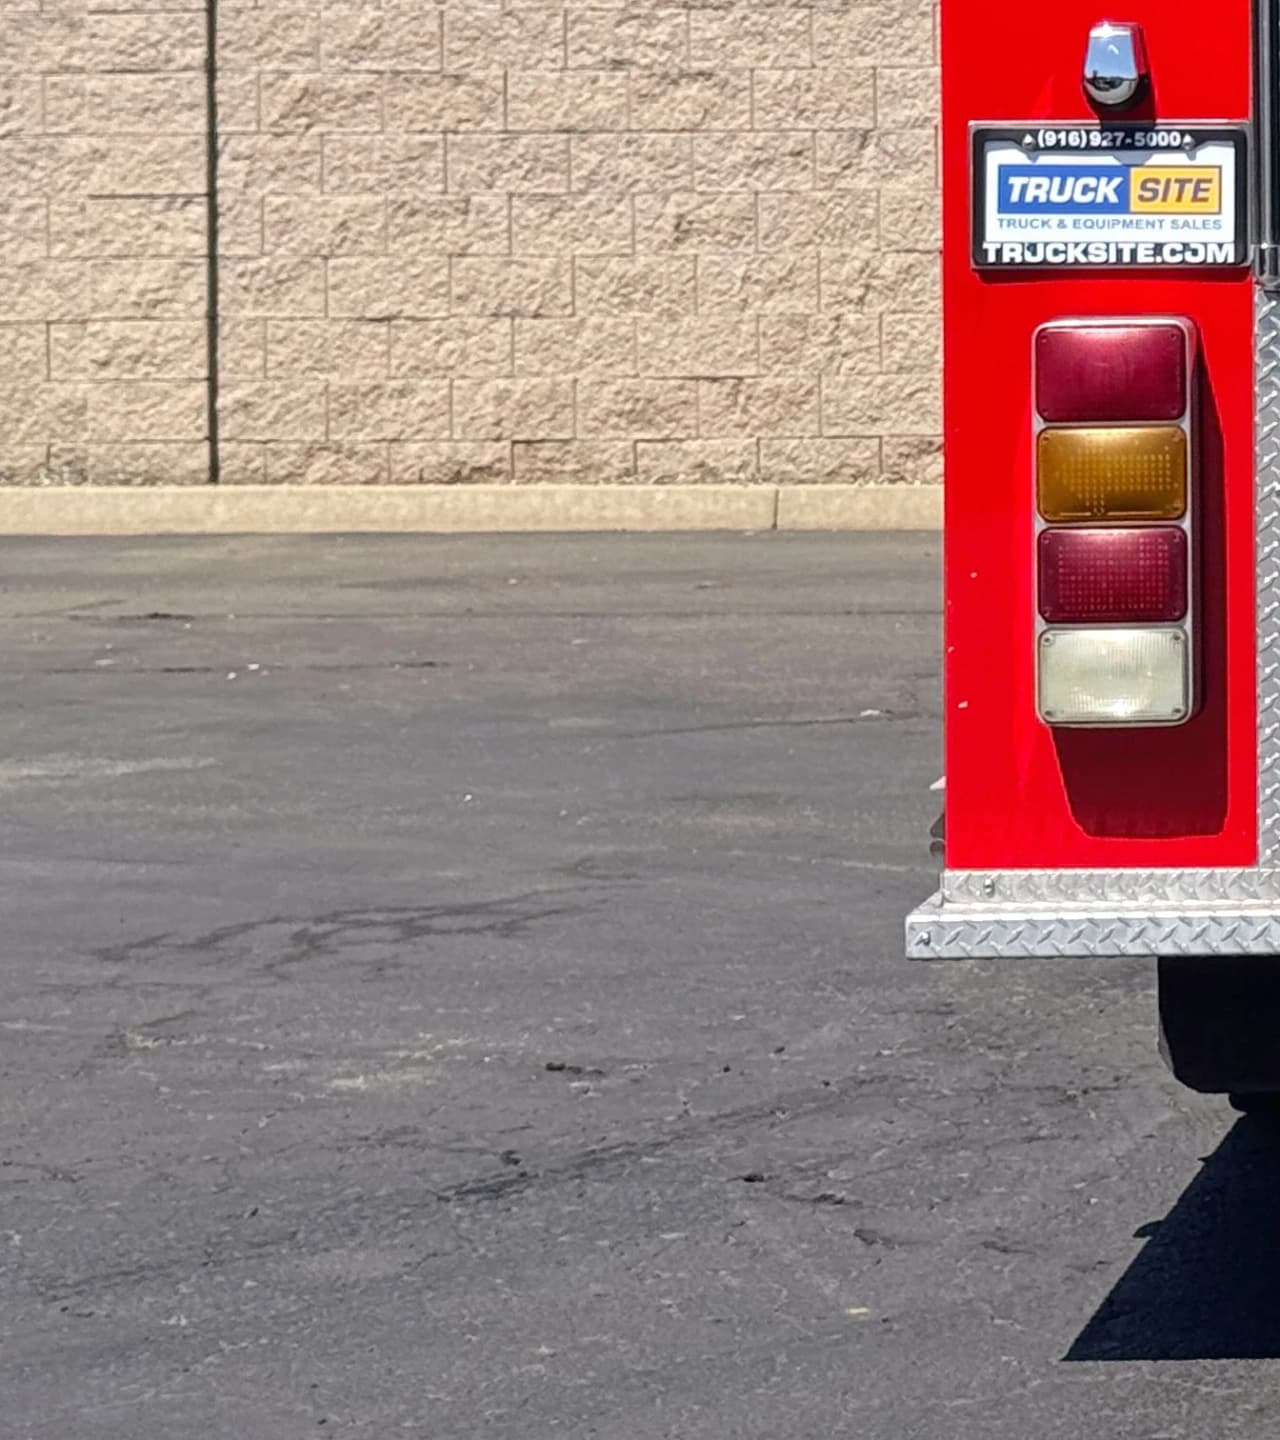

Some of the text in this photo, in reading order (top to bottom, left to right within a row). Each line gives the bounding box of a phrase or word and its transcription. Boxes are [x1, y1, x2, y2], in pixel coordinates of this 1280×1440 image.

[1007, 176, 1214, 204] TRUCK SITE
[997, 218, 1223, 231] TRUCK & EQUIPMENT SALES
[982, 241, 1236, 264] TRUCKSITE.COM
